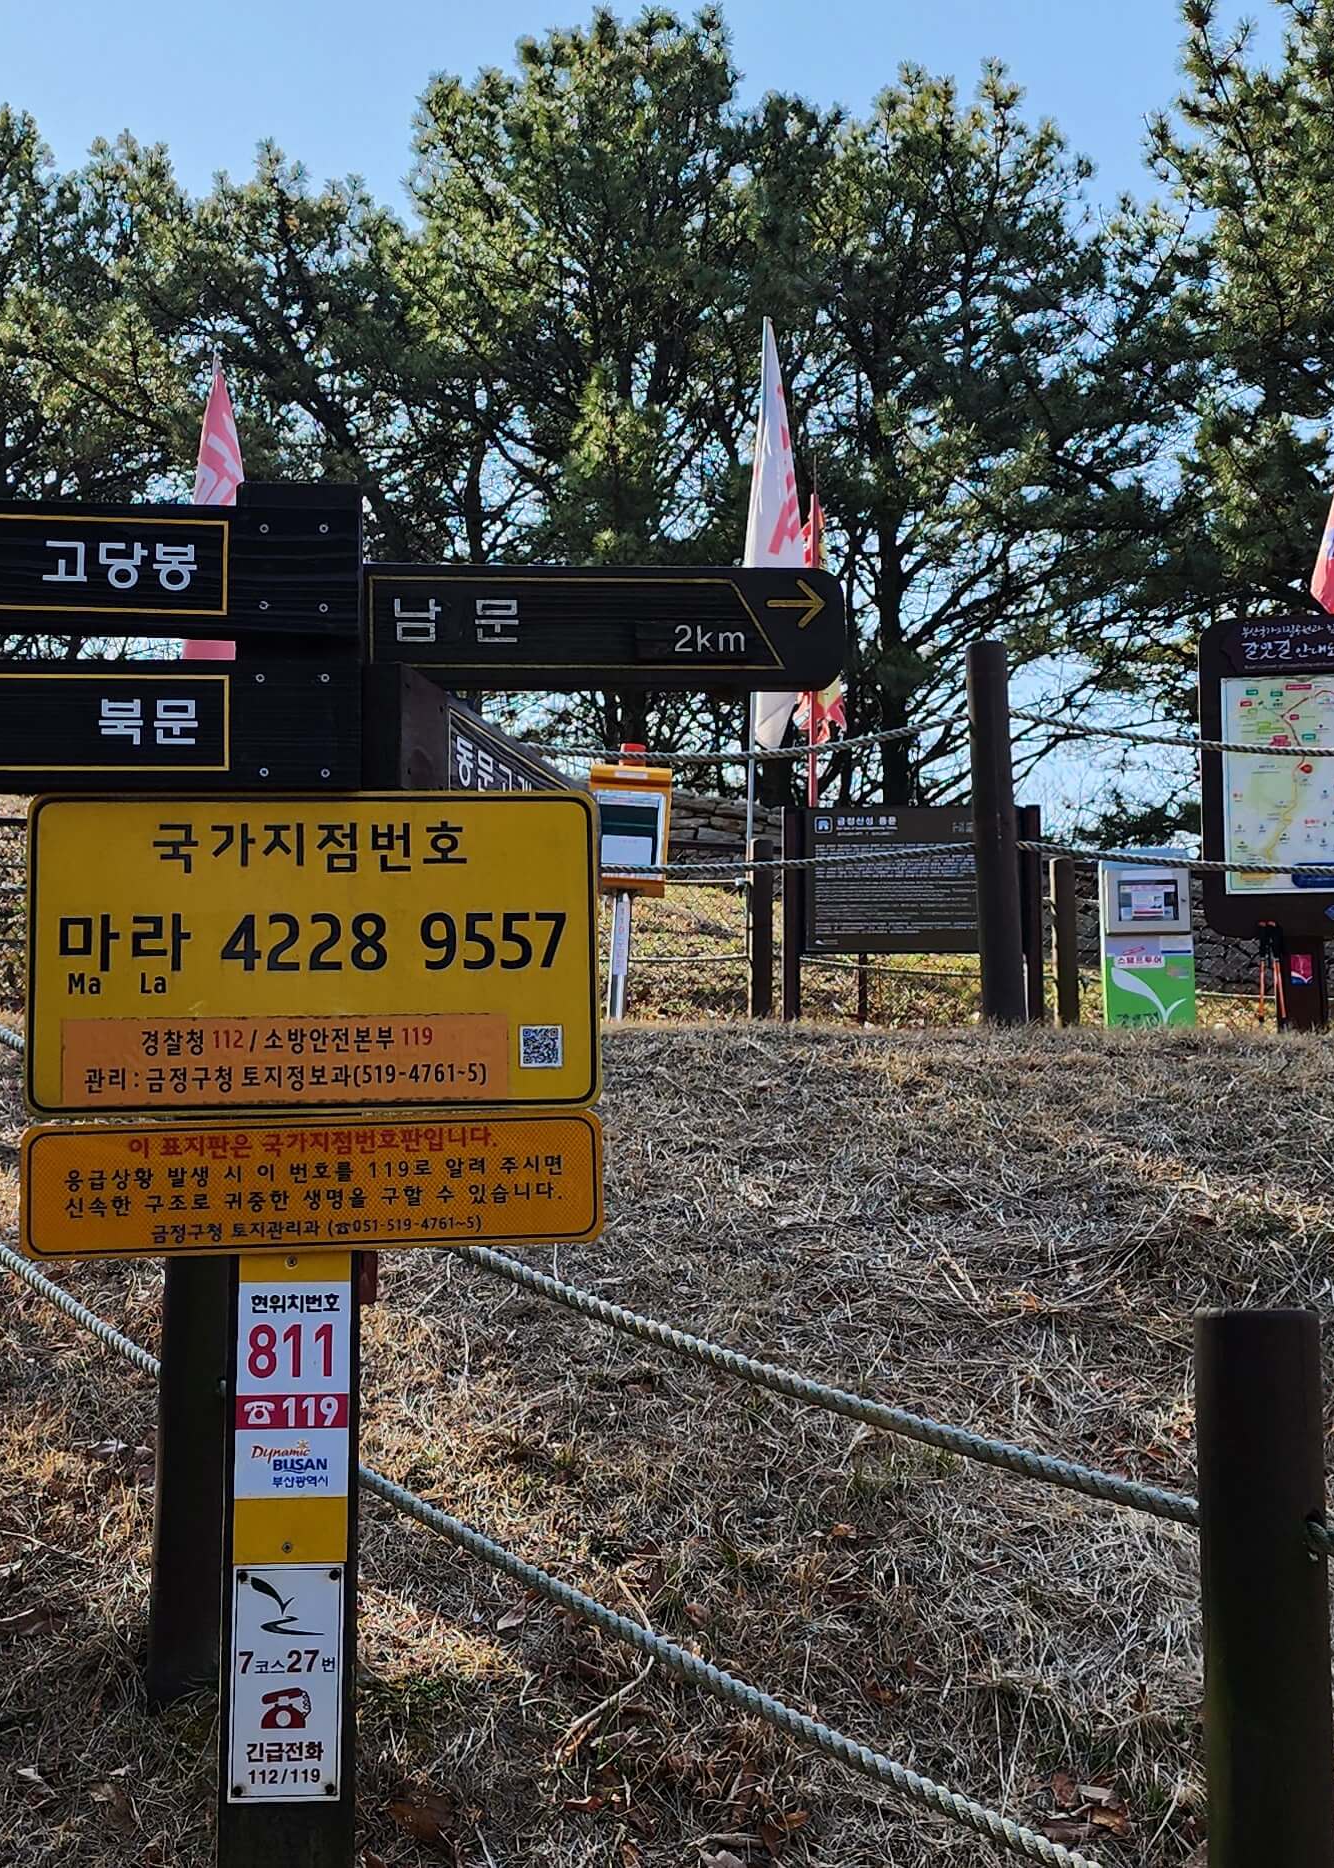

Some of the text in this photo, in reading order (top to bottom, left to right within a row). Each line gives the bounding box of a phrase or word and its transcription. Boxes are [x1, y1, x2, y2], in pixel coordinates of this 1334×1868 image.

[42, 540, 198, 590] 고당봉
[674, 624, 746, 653] 2km
[99, 699, 198, 746] 북문
[153, 821, 467, 873] 국가지점번호
[220, 913, 387, 971] 4228
[419, 911, 567, 970] 9557
[67, 972, 167, 995] Ma La
[141, 1029, 204, 1056] 경찰청
[264, 1027, 395, 1055] 소방안전본부
[401, 1026, 433, 1046] 119
[145, 1066, 233, 1093] 금정구청
[128, 1126, 498, 1160] 이 표지판은 국가지점번호판입니다.
[64, 1154, 563, 1192] 응급상황 발생 시 이 번호를 119로 알려 주시면
[65, 1181, 563, 1219] 신속한 구조로 귀중한 생명을 구할 수 있습니다.
[151, 1223, 223, 1244] 금정구청
[231, 1220, 320, 1240] 토지관리과
[251, 1293, 340, 1314] 현위치번호
[247, 1324, 334, 1378] 811
[282, 1397, 339, 1427] 119
[251, 1444, 310, 1464] Dynamic
[273, 1458, 328, 1473] BUSAN
[272, 1475, 328, 1489] 부산광역시
[246, 1742, 324, 1763] 긴급전화
[248, 1768, 321, 1785] 112/119
